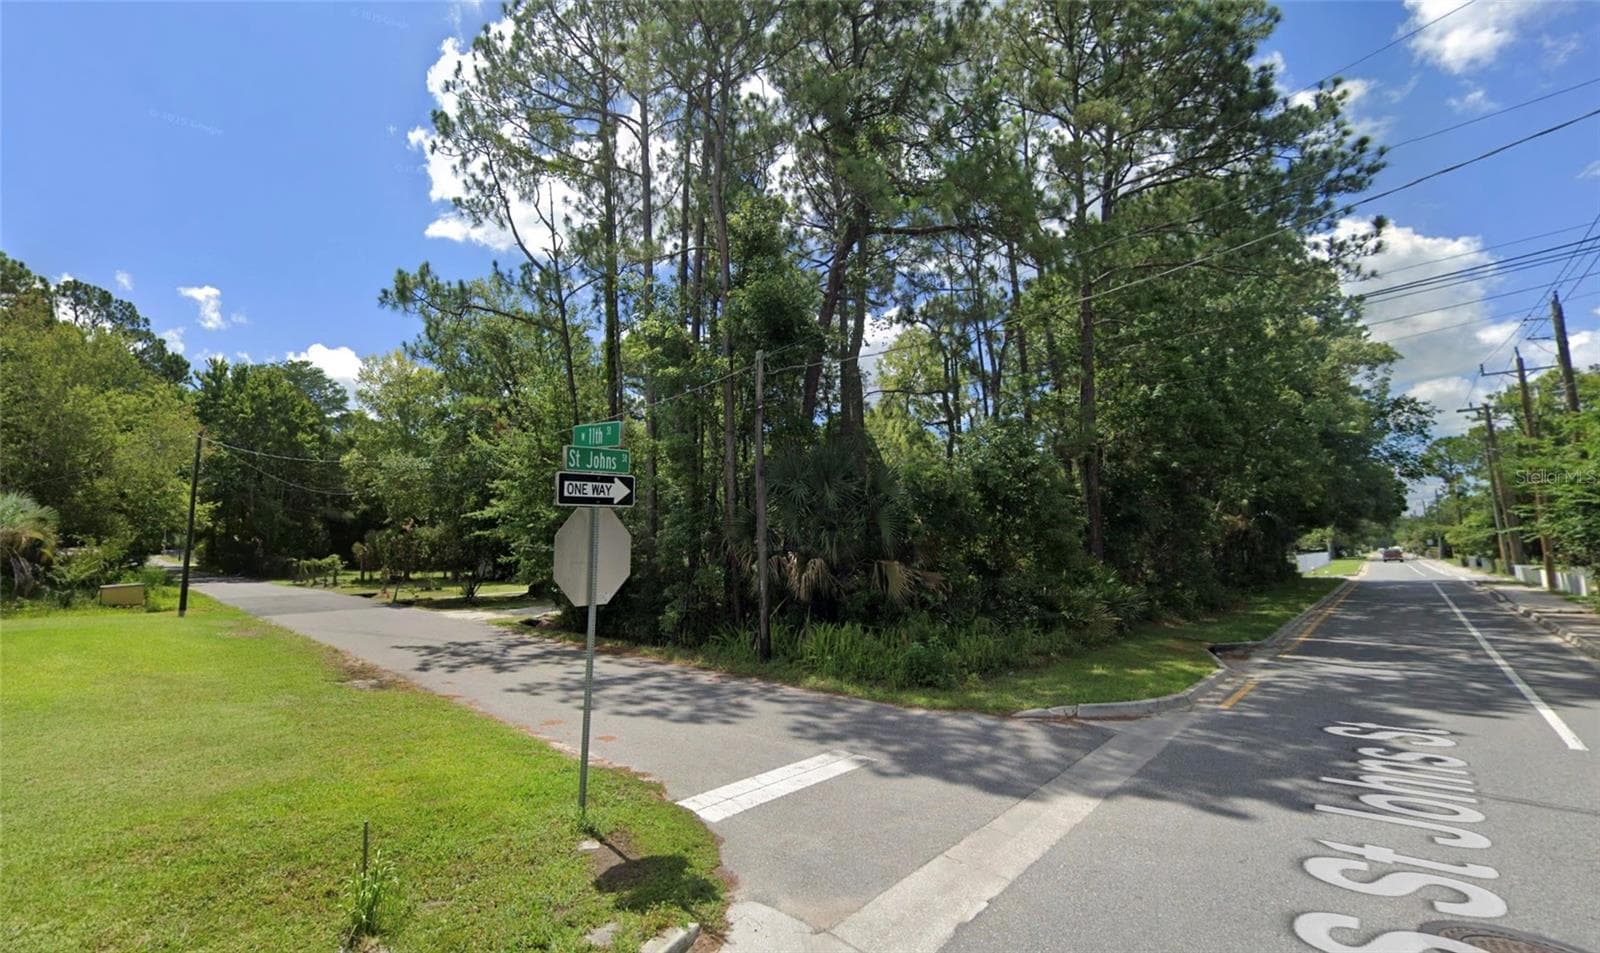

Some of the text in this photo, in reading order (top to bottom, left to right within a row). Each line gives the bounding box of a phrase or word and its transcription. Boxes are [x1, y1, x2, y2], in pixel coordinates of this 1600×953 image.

[589, 427, 603, 445] 11th
[569, 449, 580, 468] St
[586, 451, 616, 470] Johns
[567, 482, 612, 496] ONE WAY
